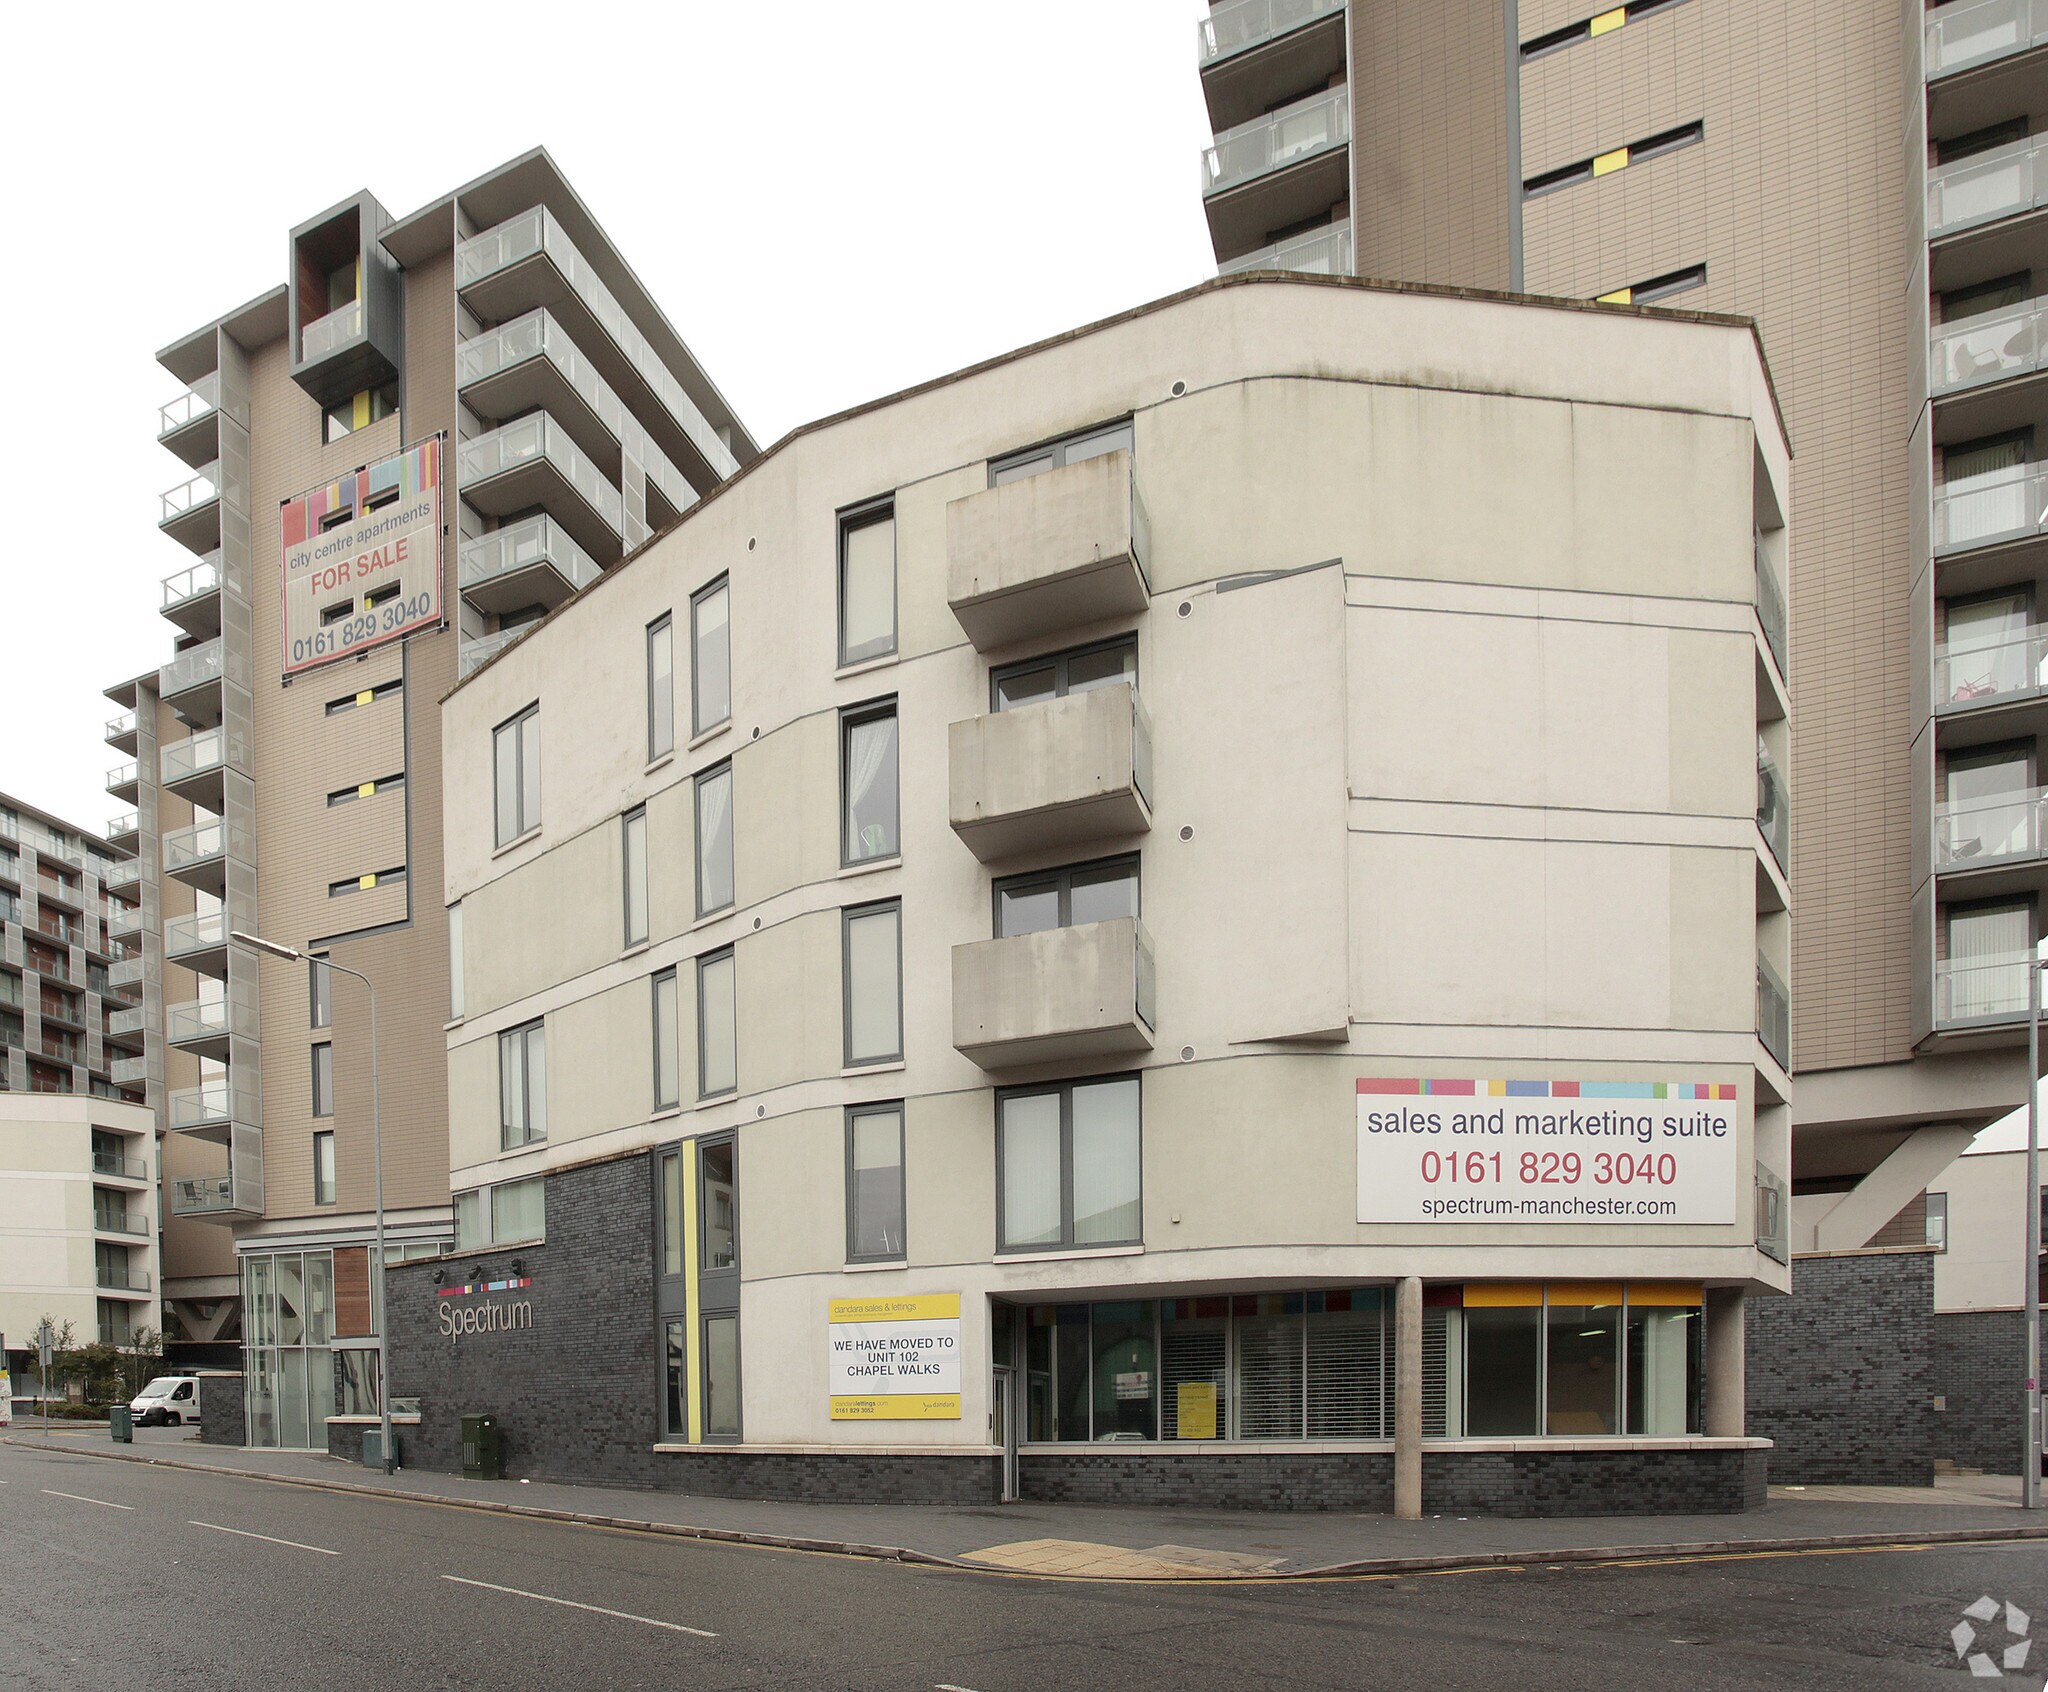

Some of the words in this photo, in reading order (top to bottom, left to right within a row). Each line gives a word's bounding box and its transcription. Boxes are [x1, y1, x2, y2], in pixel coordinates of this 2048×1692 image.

[290, 549, 311, 570] city
[315, 535, 353, 560] centre
[357, 502, 431, 544] apartments
[311, 561, 351, 596] FOR
[357, 538, 409, 578] SALE
[293, 629, 335, 662] 0161
[342, 613, 377, 646] 829
[382, 591, 431, 632] 3040
[1367, 1107, 1442, 1135] sales
[1452, 1108, 1504, 1135] and
[1515, 1109, 1653, 1144] marketing
[1662, 1111, 1728, 1138] suite
[1420, 1150, 1503, 1184] 0161
[1519, 1151, 1582, 1185] 829
[1593, 1152, 1678, 1186] 3040
[1421, 1196, 1677, 1219] spectrum-manchester.com
[440, 1299, 533, 1344] Spectrum
[834, 1304, 864, 1314] dandara
[865, 1304, 883, 1313] sales
[884, 1303, 890, 1311] &
[892, 1302, 917, 1312] lettings
[834, 1340, 852, 1351] WE
[855, 1339, 887, 1351] HAVE
[889, 1338, 934, 1350] MOVED
[937, 1337, 954, 1348] TO
[868, 1352, 896, 1363] UNIT
[899, 1351, 919, 1362] 102
[847, 1365, 895, 1377] CHAPEL
[897, 1363, 941, 1375] WALKS
